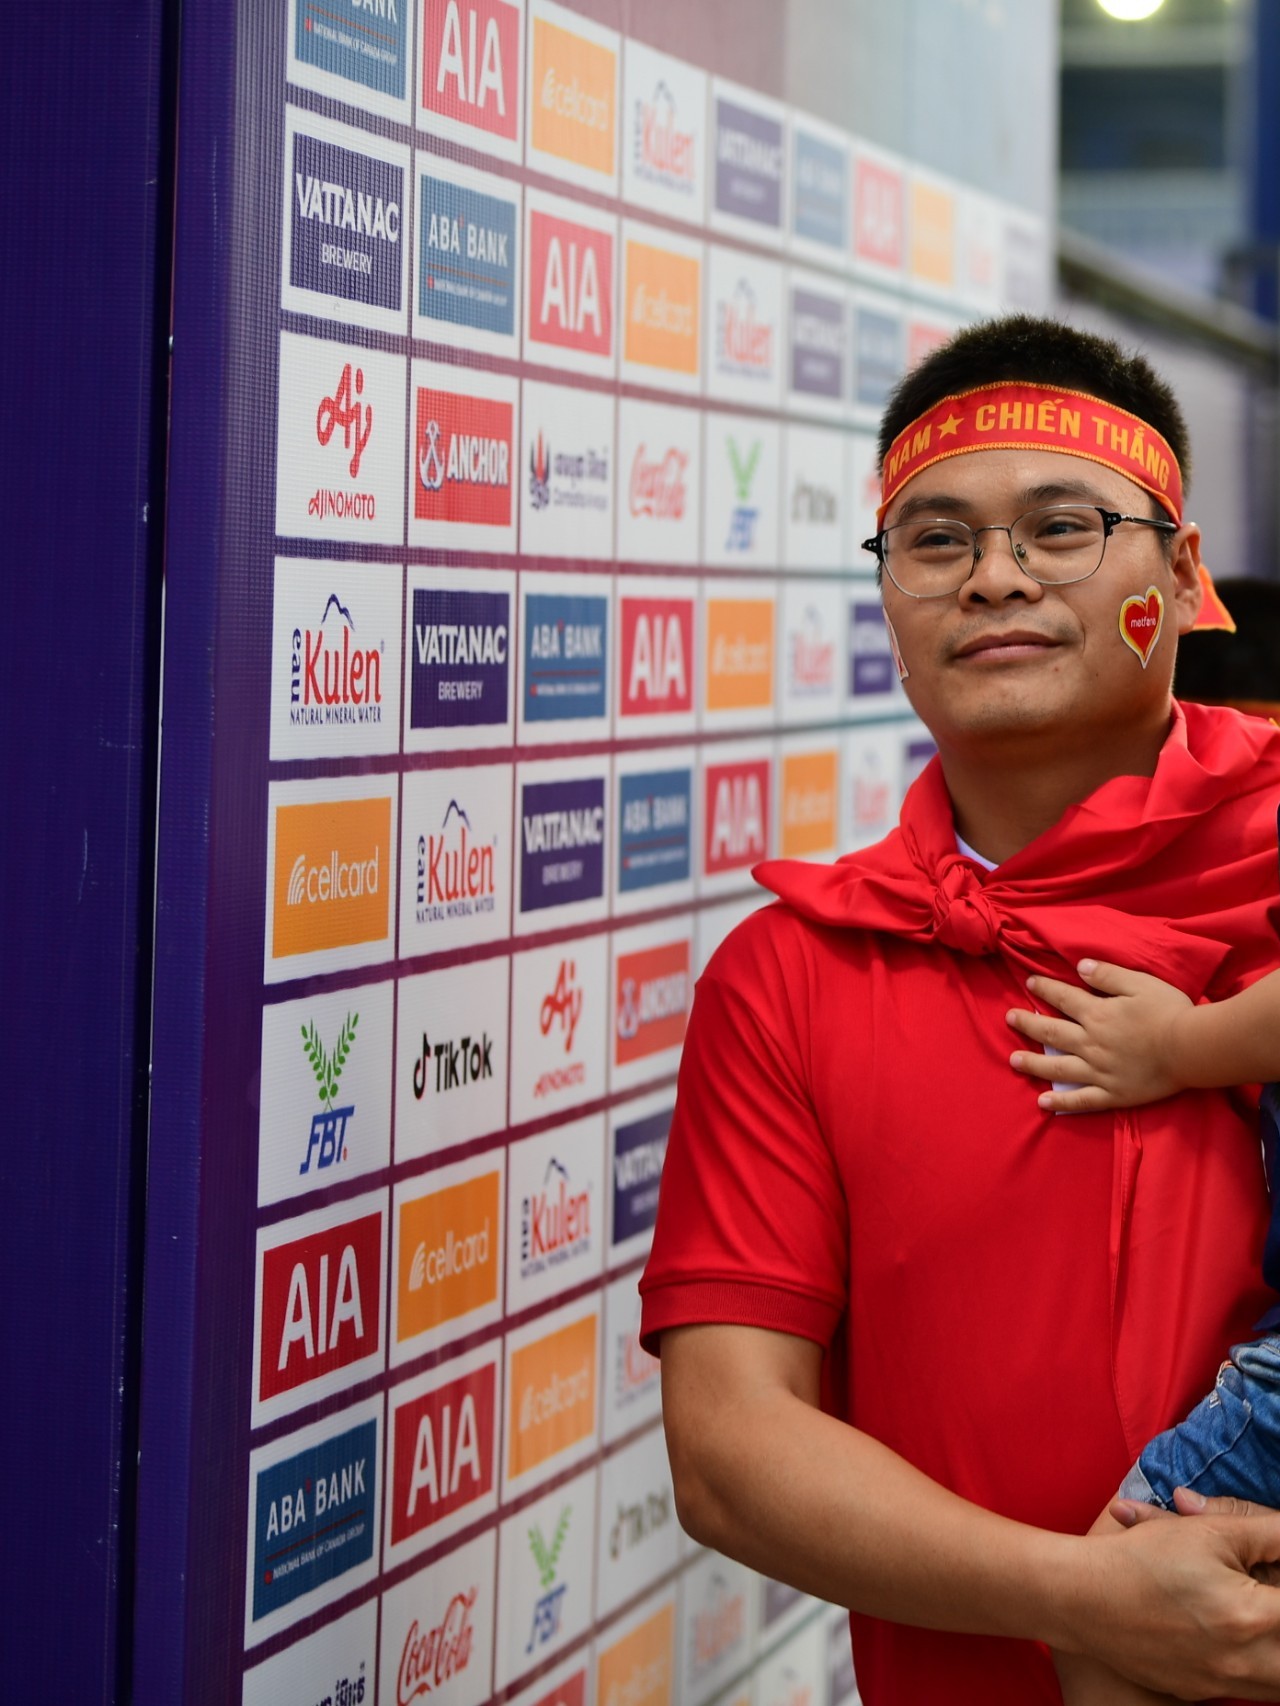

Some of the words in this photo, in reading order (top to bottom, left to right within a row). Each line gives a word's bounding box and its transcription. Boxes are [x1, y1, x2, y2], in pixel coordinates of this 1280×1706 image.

[437, 0, 505, 117] AIA
[297, 173, 399, 243] VATTANAC
[428, 213, 460, 256] ABA
[467, 223, 508, 268] BANK
[322, 243, 373, 275] BREWERY
[540, 236, 602, 338] AIA
[447, 433, 509, 487] ANCHOR
[888, 424, 932, 484] NAM
[975, 398, 1081, 439] CHIẾN
[1091, 415, 1170, 492] THẮNG
[308, 489, 375, 521] AJINOMOTO
[303, 625, 382, 705] Kulen
[416, 624, 507, 665] VATTANAC
[531, 624, 560, 660] ABA
[564, 624, 601, 660] BANK
[628, 614, 686, 701] AIA
[290, 708, 323, 726] NATURAL
[326, 708, 356, 724] MINERAL
[358, 706, 382, 723] WATER
[438, 680, 483, 701] BREWERY
[524, 806, 604, 854] VATTANAC
[710, 773, 765, 861] AIA
[307, 845, 379, 903] cellcard
[428, 826, 495, 904] Kulen
[434, 1031, 492, 1093] TikTok
[299, 1105, 355, 1176] FBT
[425, 1215, 490, 1285] cellcard
[531, 1179, 591, 1258] Kulen
[277, 1244, 365, 1372] AIA
[406, 1394, 482, 1518] AIA
[266, 1488, 306, 1542] ABA
[315, 1458, 366, 1518] BANK
[272, 1556, 300, 1580] NATIONAL
